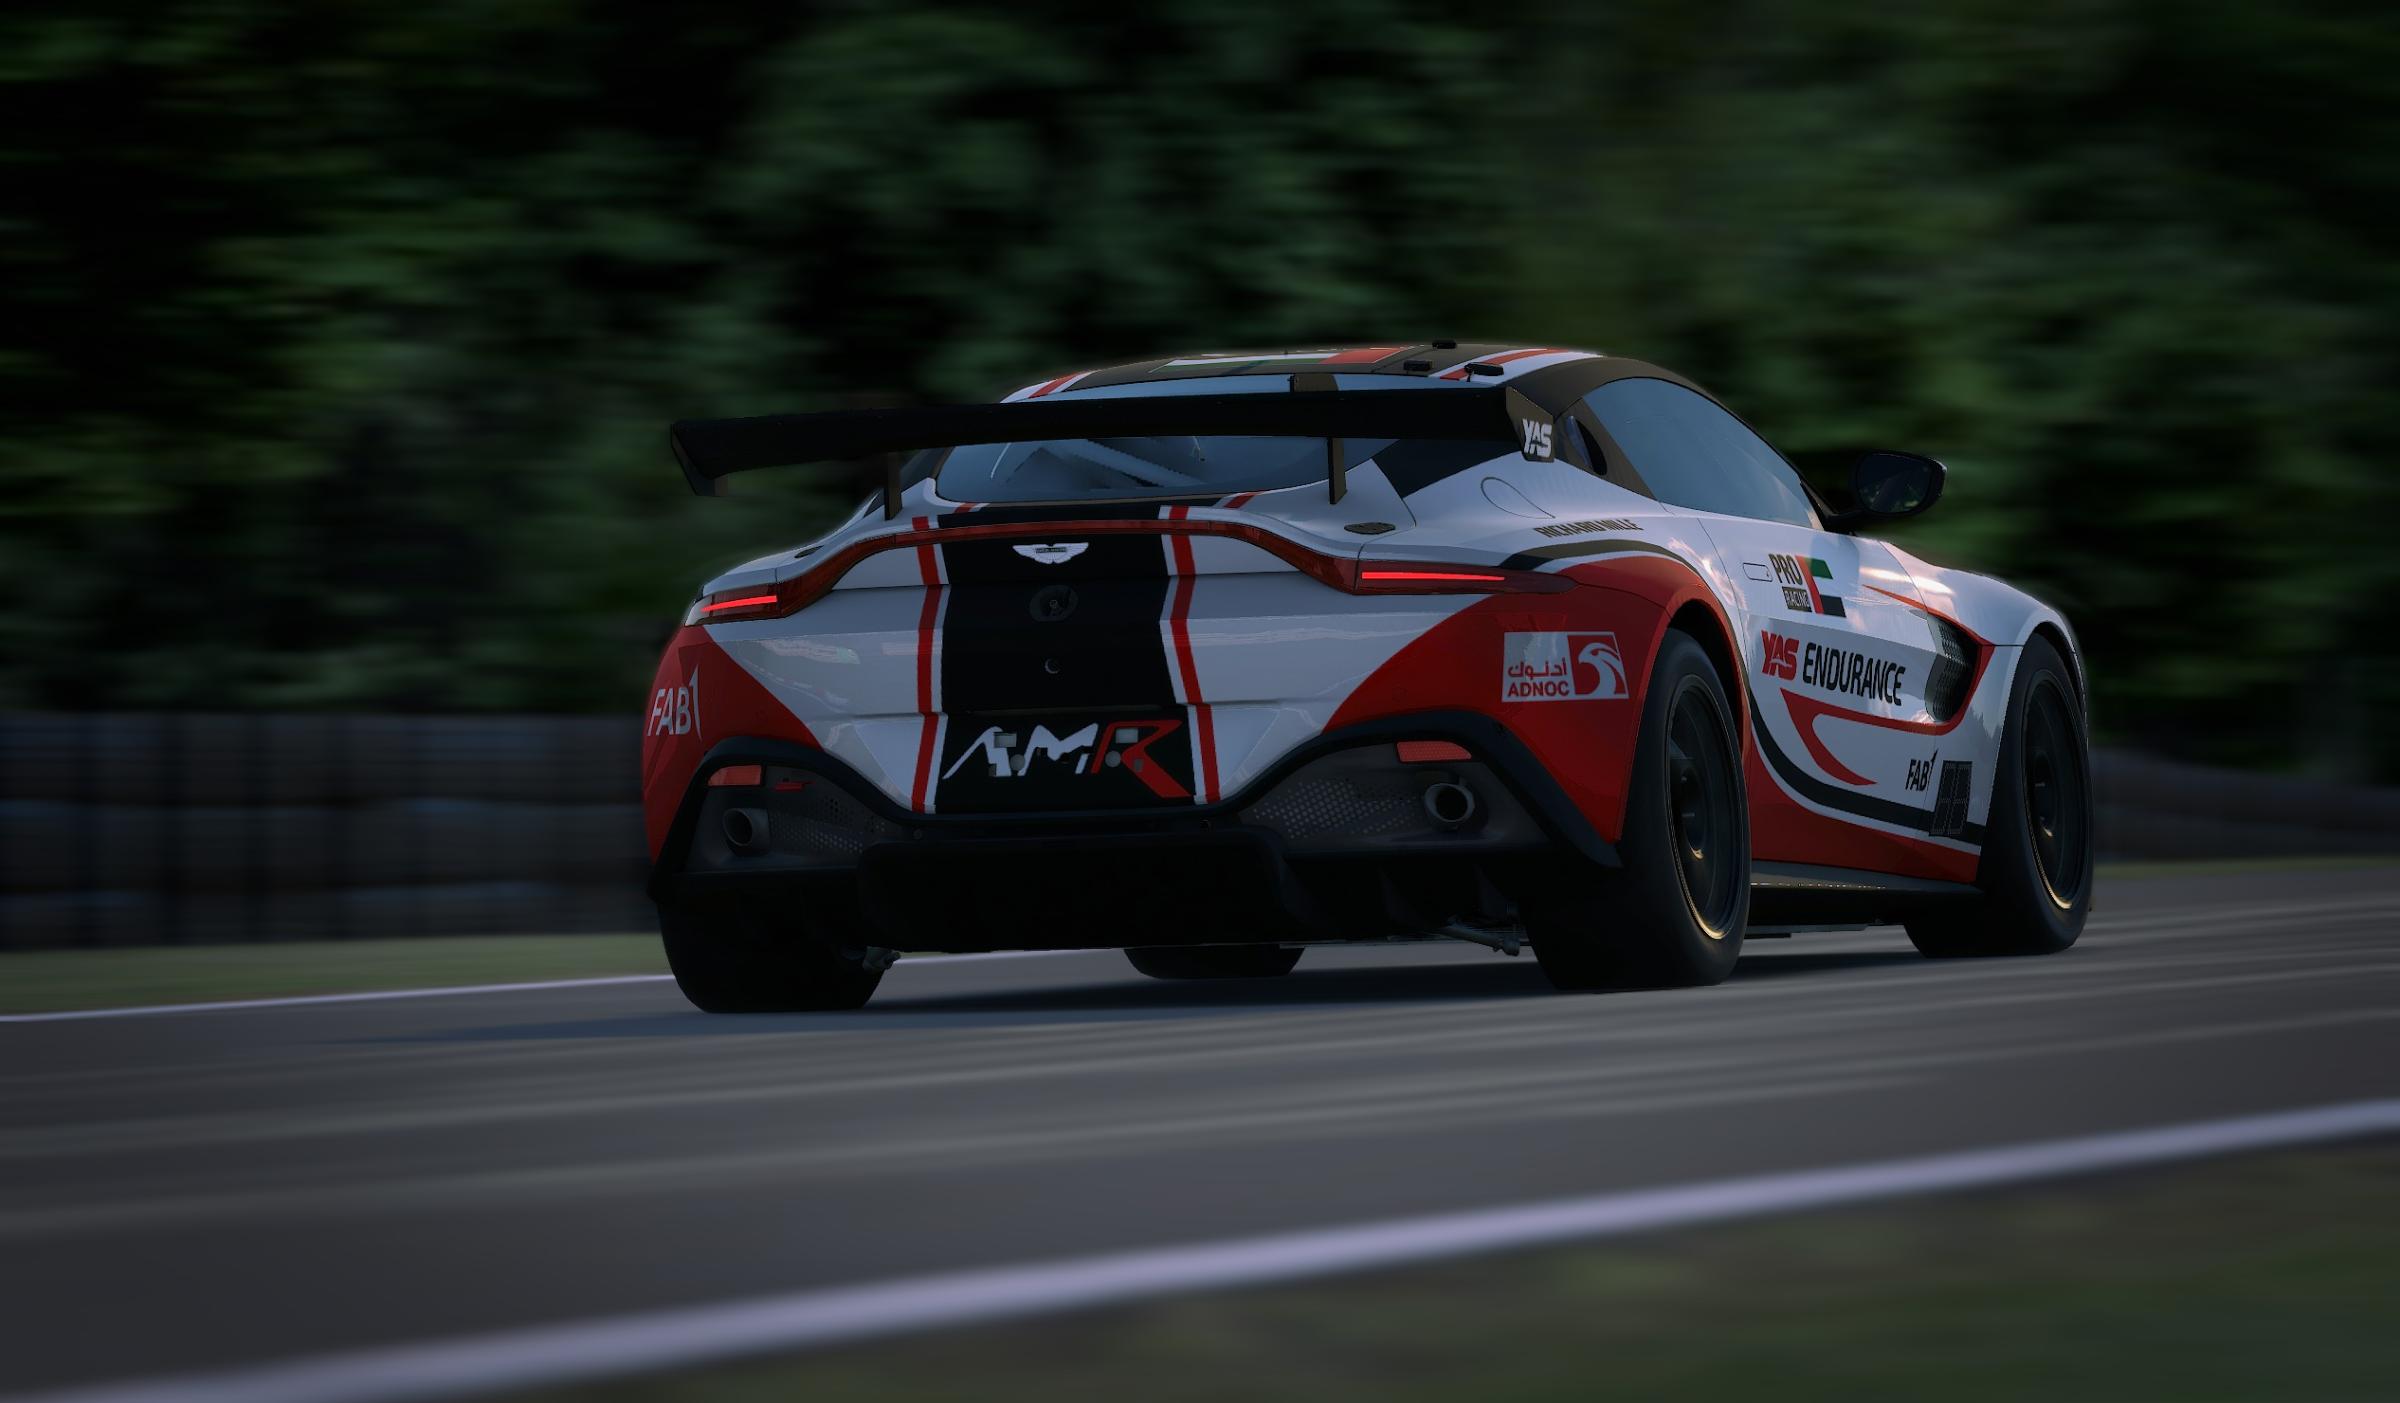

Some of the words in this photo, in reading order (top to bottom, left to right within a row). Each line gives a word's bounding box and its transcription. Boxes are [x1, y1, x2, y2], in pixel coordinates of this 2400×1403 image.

[1522, 418, 1553, 458] YAS
[1533, 520, 1608, 538] RICHARD
[1768, 553, 1803, 586] PRO
[1761, 630, 1800, 681] YAS
[1802, 642, 1906, 706] ENDURANCE
[647, 664, 703, 742] FAB1
[1507, 681, 1570, 697] ADNOC
[941, 719, 1193, 800] AMR
